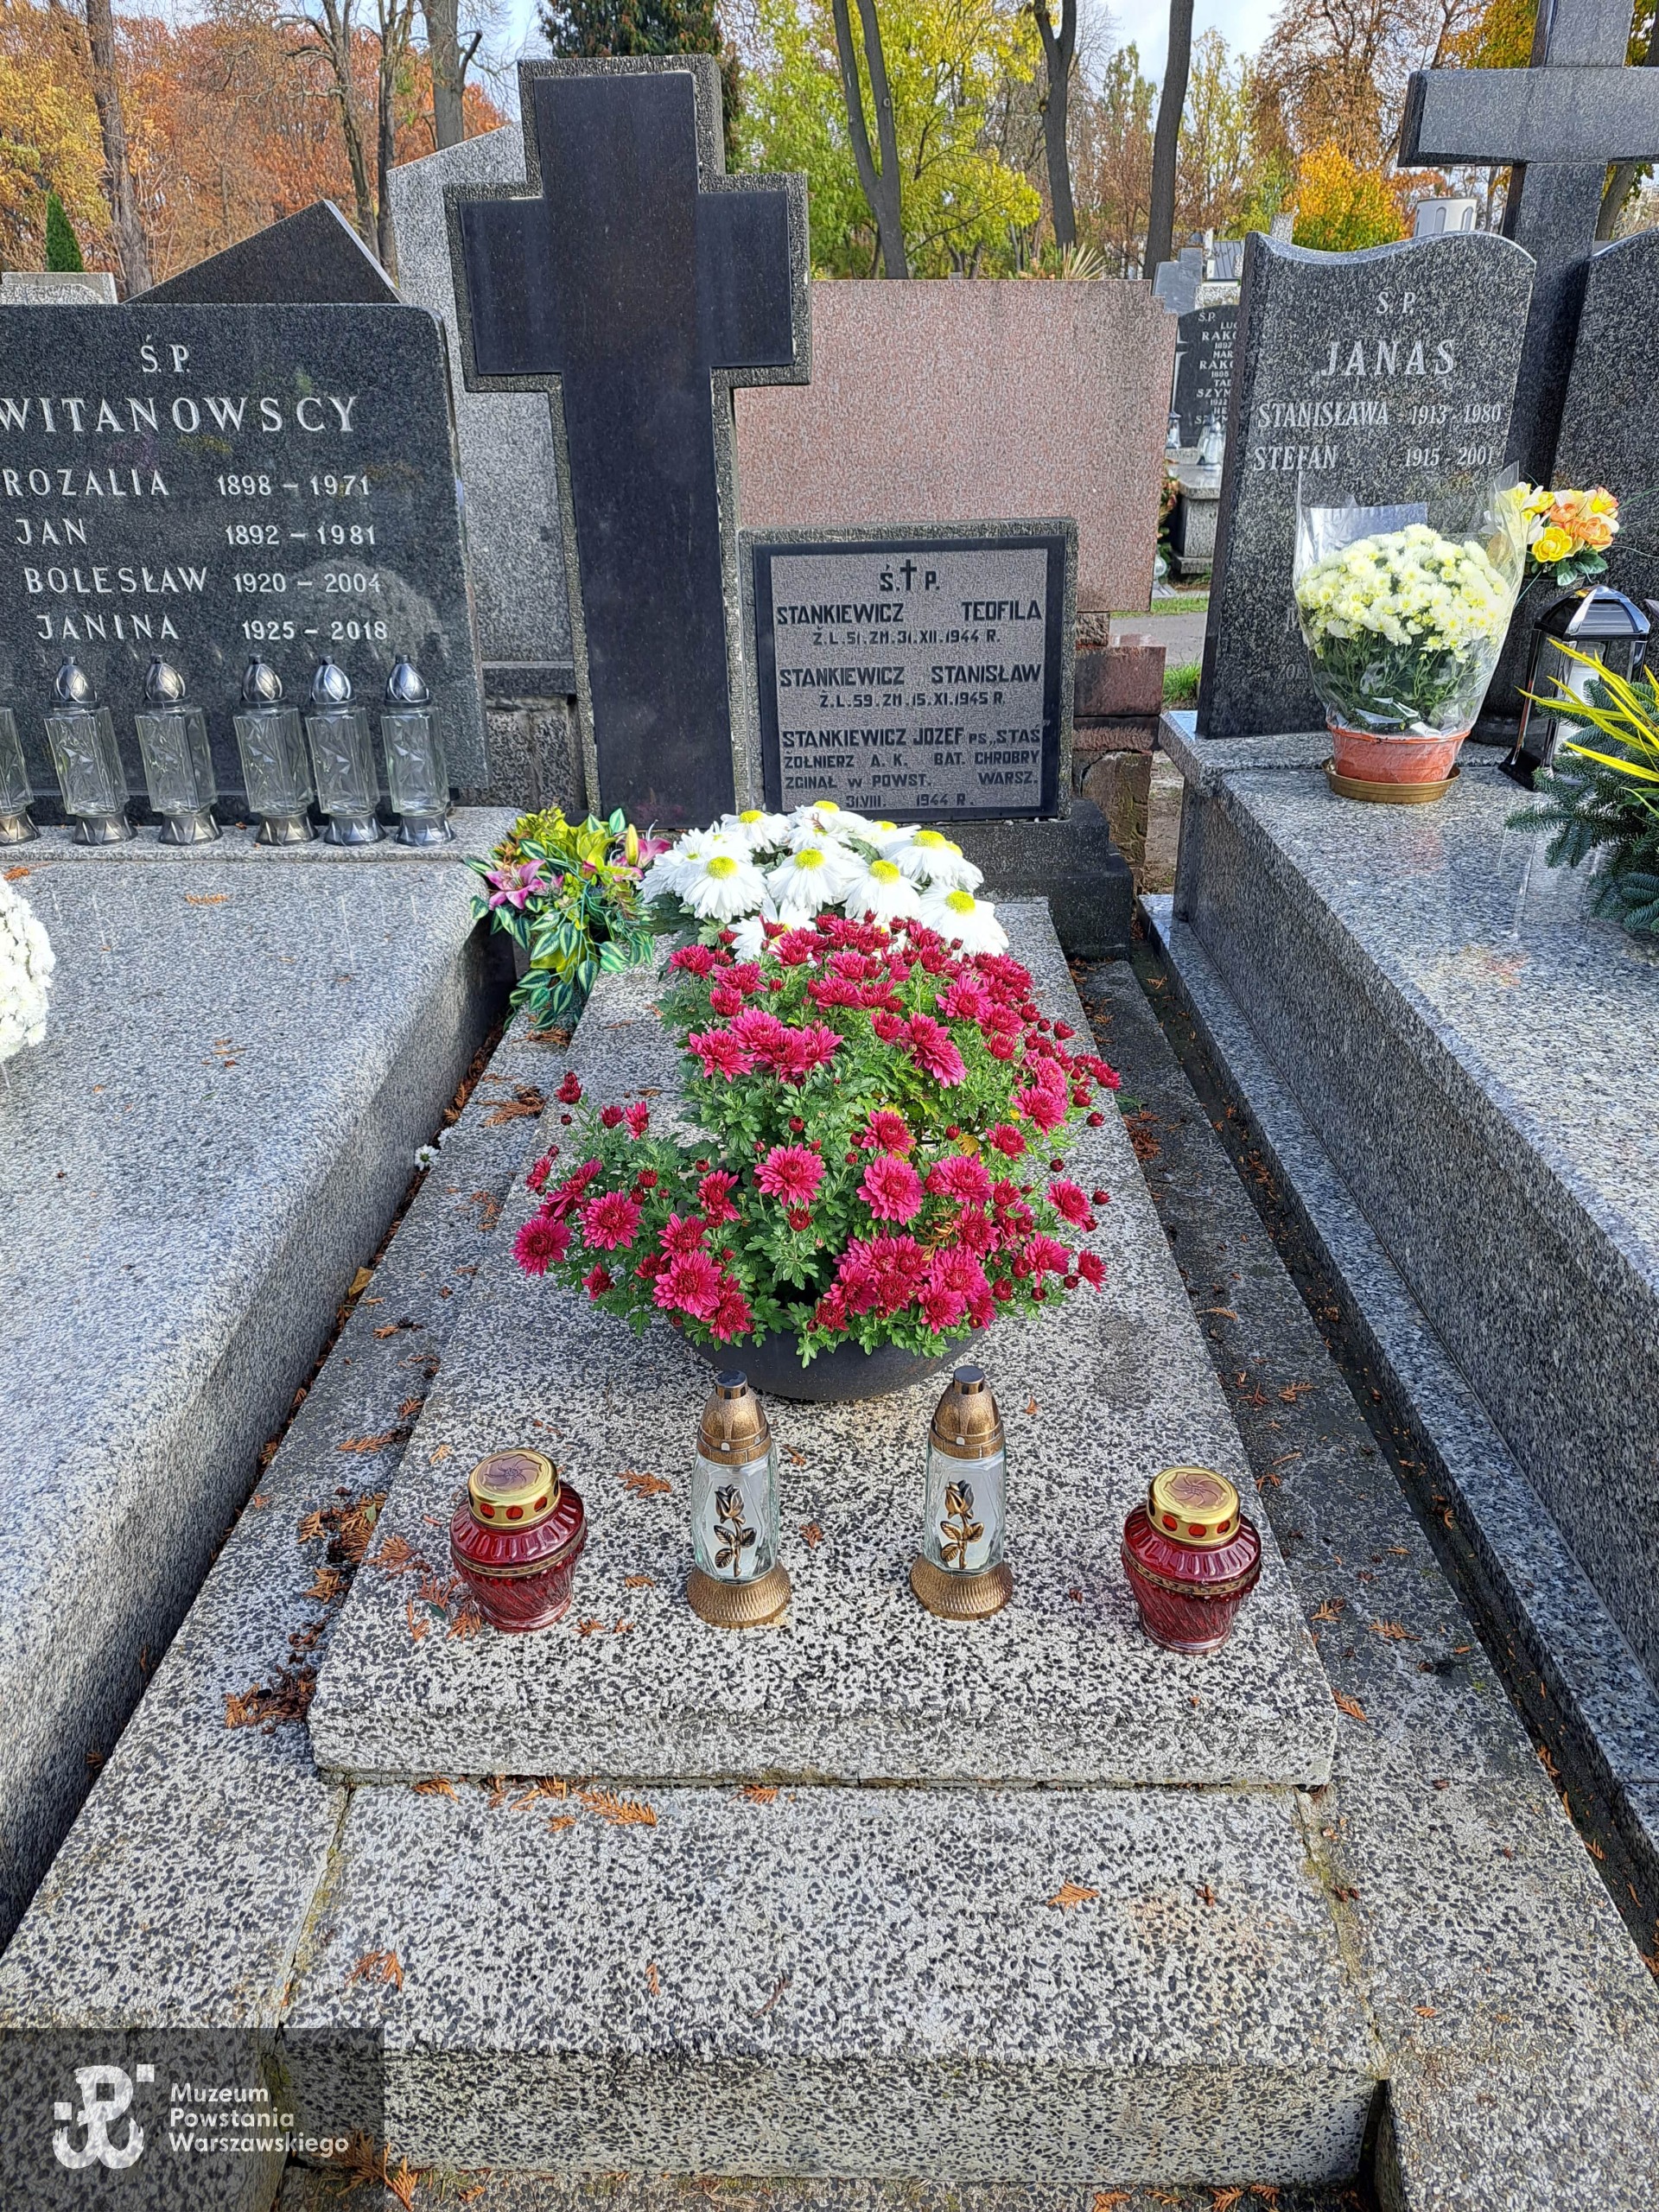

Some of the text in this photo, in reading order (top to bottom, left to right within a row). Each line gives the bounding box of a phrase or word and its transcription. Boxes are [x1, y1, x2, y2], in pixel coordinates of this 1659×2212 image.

[1321, 340, 1457, 377] JANAS
[0, 397, 358, 433] WITANOWSCY
[1257, 400, 1390, 429] STANISŁAWA
[1410, 404, 1448, 425] 1913
[1464, 404, 1501, 424] 1980
[1253, 445, 1338, 472] STEFAN
[1405, 447, 1441, 467] 1915
[1457, 446, 1494, 467] 2001
[2, 467, 169, 496] ROZALIA
[217, 474, 272, 496] 1898
[309, 474, 371, 496] 1971
[16, 518, 87, 546] JAN
[225, 524, 280, 545] 1892
[316, 524, 377, 545] 1981
[24, 567, 208, 594] BOLESŁAW
[232, 572, 287, 593] 1920
[325, 572, 381, 594] 2004
[777, 600, 1043, 625] STANKIEWICZ TEOFILA
[36, 614, 179, 640] JANINA
[242, 620, 295, 640] 1925
[331, 620, 389, 640] 2018
[986, 628, 1001, 643] R.
[779, 664, 1042, 688] STANKIEWICZ STANISŁAW
[994, 690, 1006, 705] R.
[782, 728, 907, 748] STANKIEWICZ
[784, 749, 1040, 769] ŻOŁNIERZ A. K. BAT. CHROBRY
[872, 773, 931, 788] POWST.
[977, 770, 1039, 785] WARSZ.
[916, 792, 950, 807] 1944
